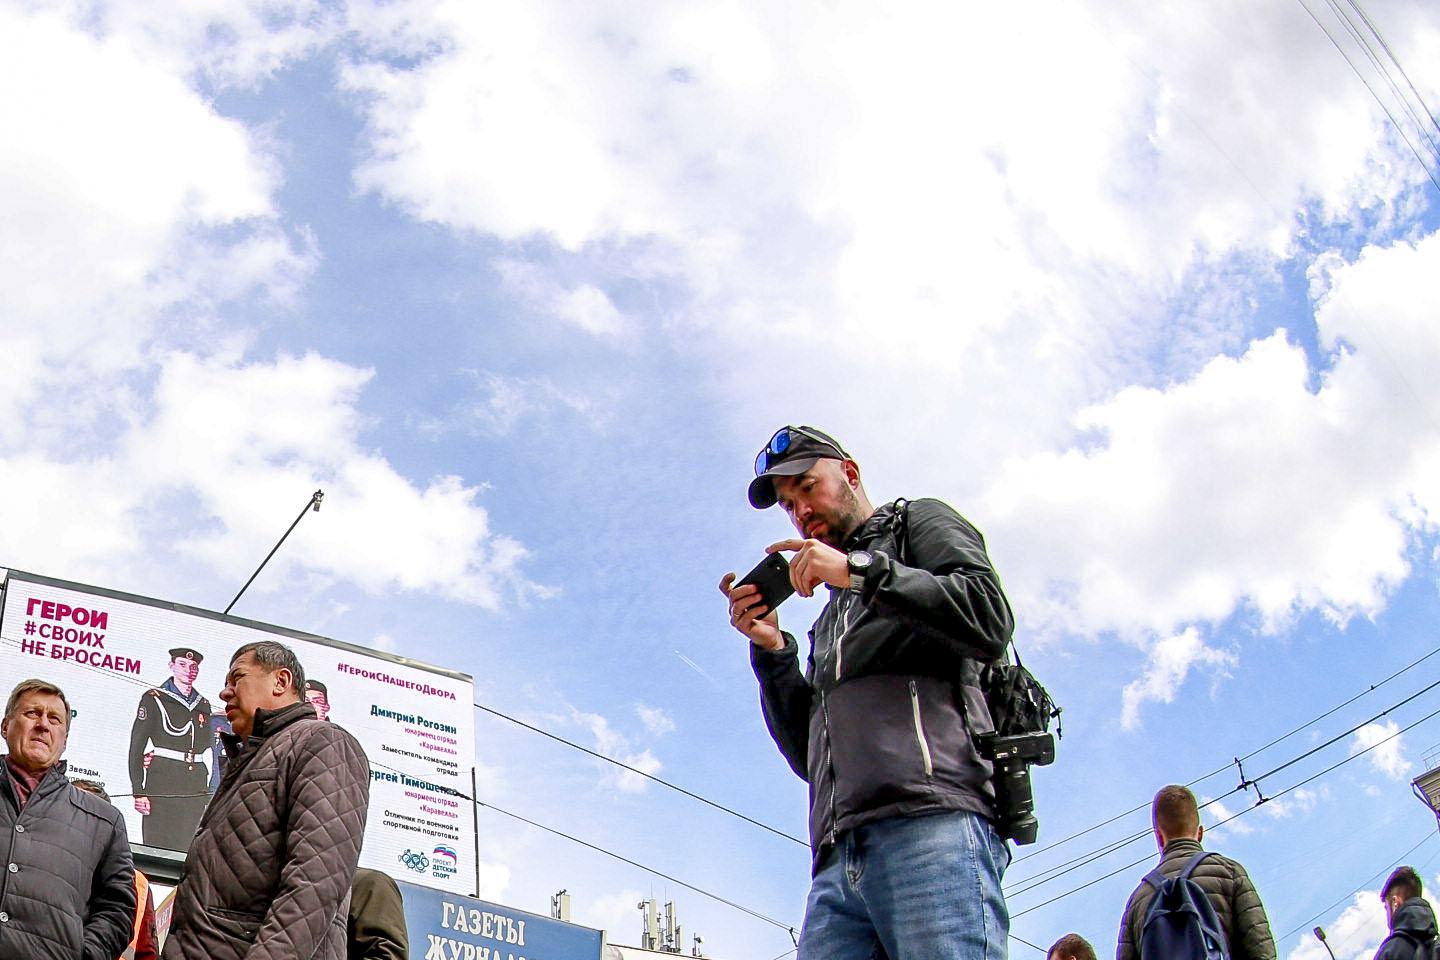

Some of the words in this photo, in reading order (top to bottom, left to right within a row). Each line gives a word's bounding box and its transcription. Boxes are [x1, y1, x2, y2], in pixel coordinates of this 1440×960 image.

[26, 597, 108, 630] ГЕРОИ
[24, 620, 105, 649] #СВОИХ
[21, 639, 46, 656] НЕ
[51, 644, 141, 675] БРОСАЕМ
[370, 704, 415, 725] Дмитрий
[417, 715, 457, 735] Рогозин
[437, 735, 457, 745] отряда
[381, 744, 422, 760] Заместитель
[423, 755, 458, 768] командира
[68, 764, 101, 778] Звезды,
[369, 769, 398, 783] ергей
[436, 767, 458, 777] отряда
[404, 790, 437, 803] юнармеец
[438, 797, 458, 808] отряда
[382, 820, 421, 833] спортивной
[422, 828, 459, 841] подготовке
[384, 809, 415, 822] Отличник
[426, 820, 453, 831] военной
[432, 864, 457, 874] ДЕТСКИЙ
[432, 871, 450, 880] СПОРТ
[441, 901, 525, 946] ГАЗЕТЫ
